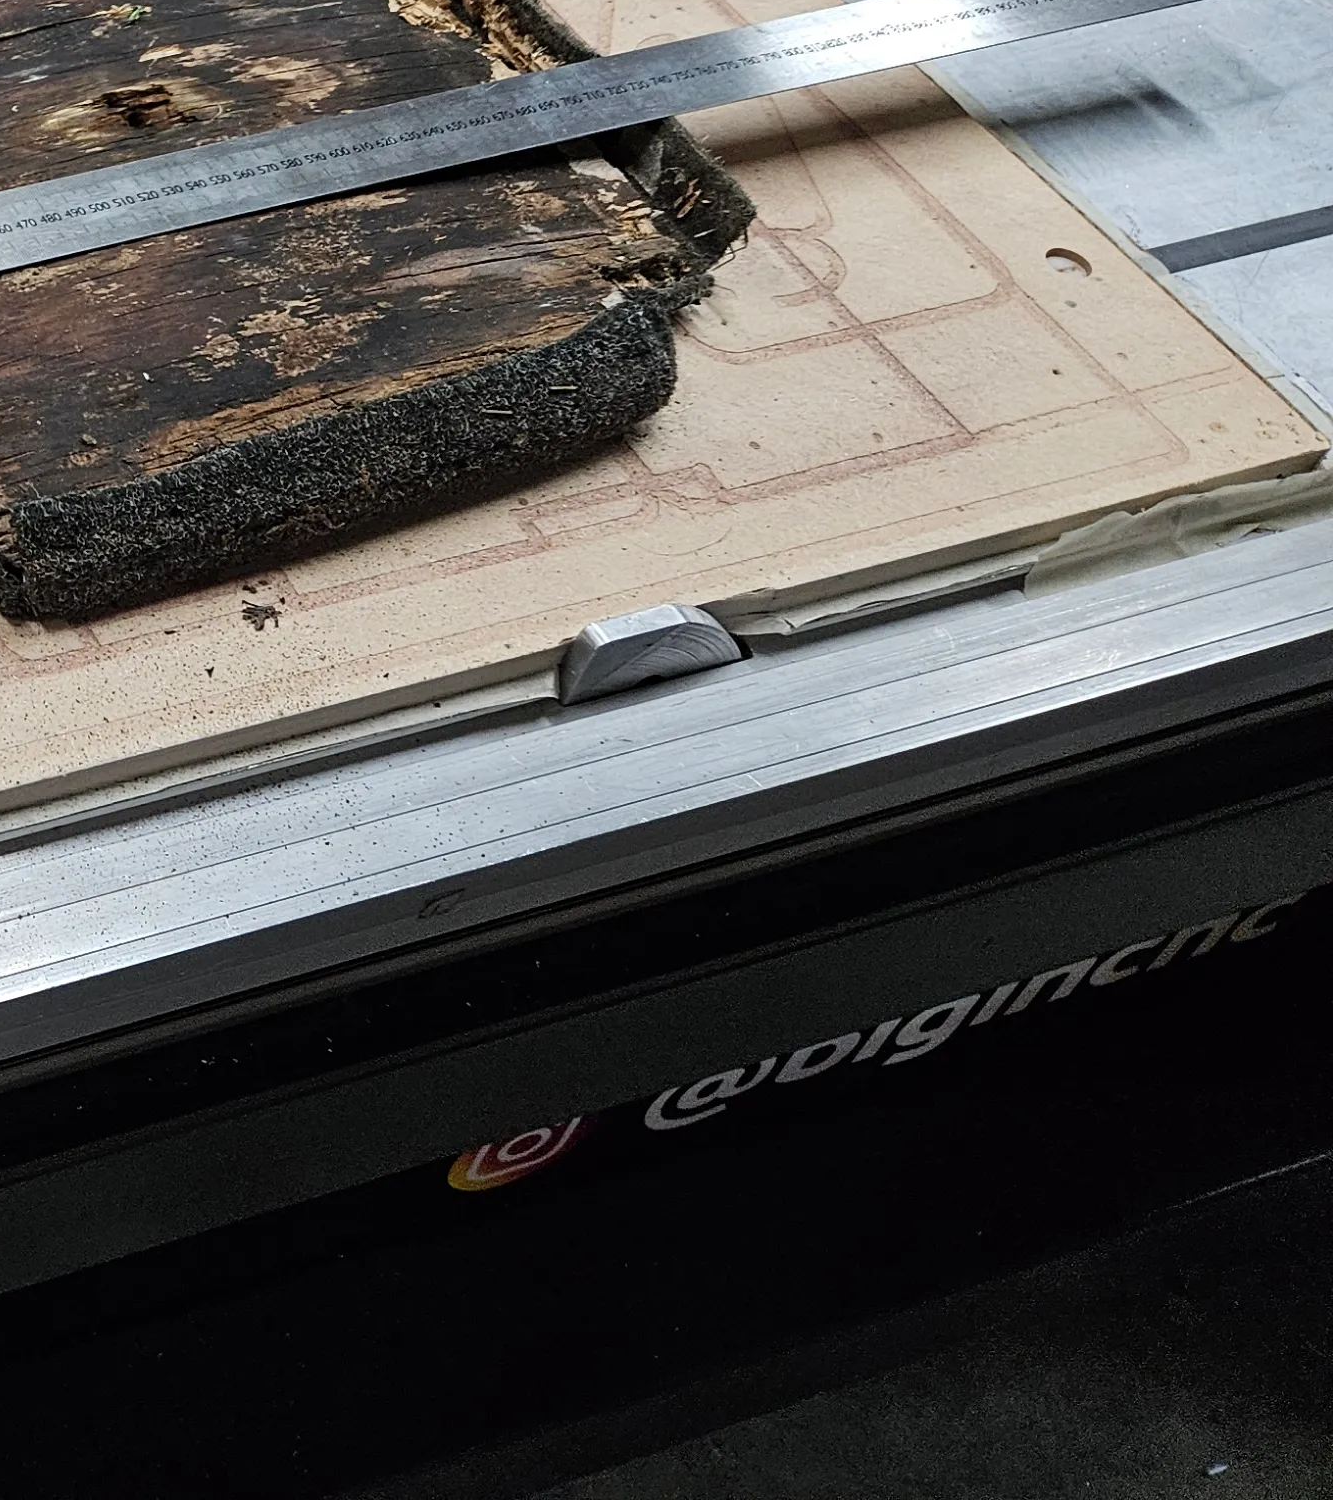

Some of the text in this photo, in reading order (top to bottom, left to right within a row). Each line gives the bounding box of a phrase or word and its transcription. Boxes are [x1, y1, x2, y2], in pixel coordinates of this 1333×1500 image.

[16, 218, 37, 230] 470
[40, 212, 62, 224] 480
[65, 206, 86, 219] 490
[89, 201, 111, 214] 500
[112, 195, 135, 208] 510
[137, 190, 159, 202] 520
[161, 184, 183, 196] 530
[185, 179, 207, 191] 540
[209, 173, 231, 185] 550
[233, 168, 255, 180] 560
[257, 162, 279, 175] 570
[281, 157, 303, 169] 580
[304, 152, 327, 164] 590
